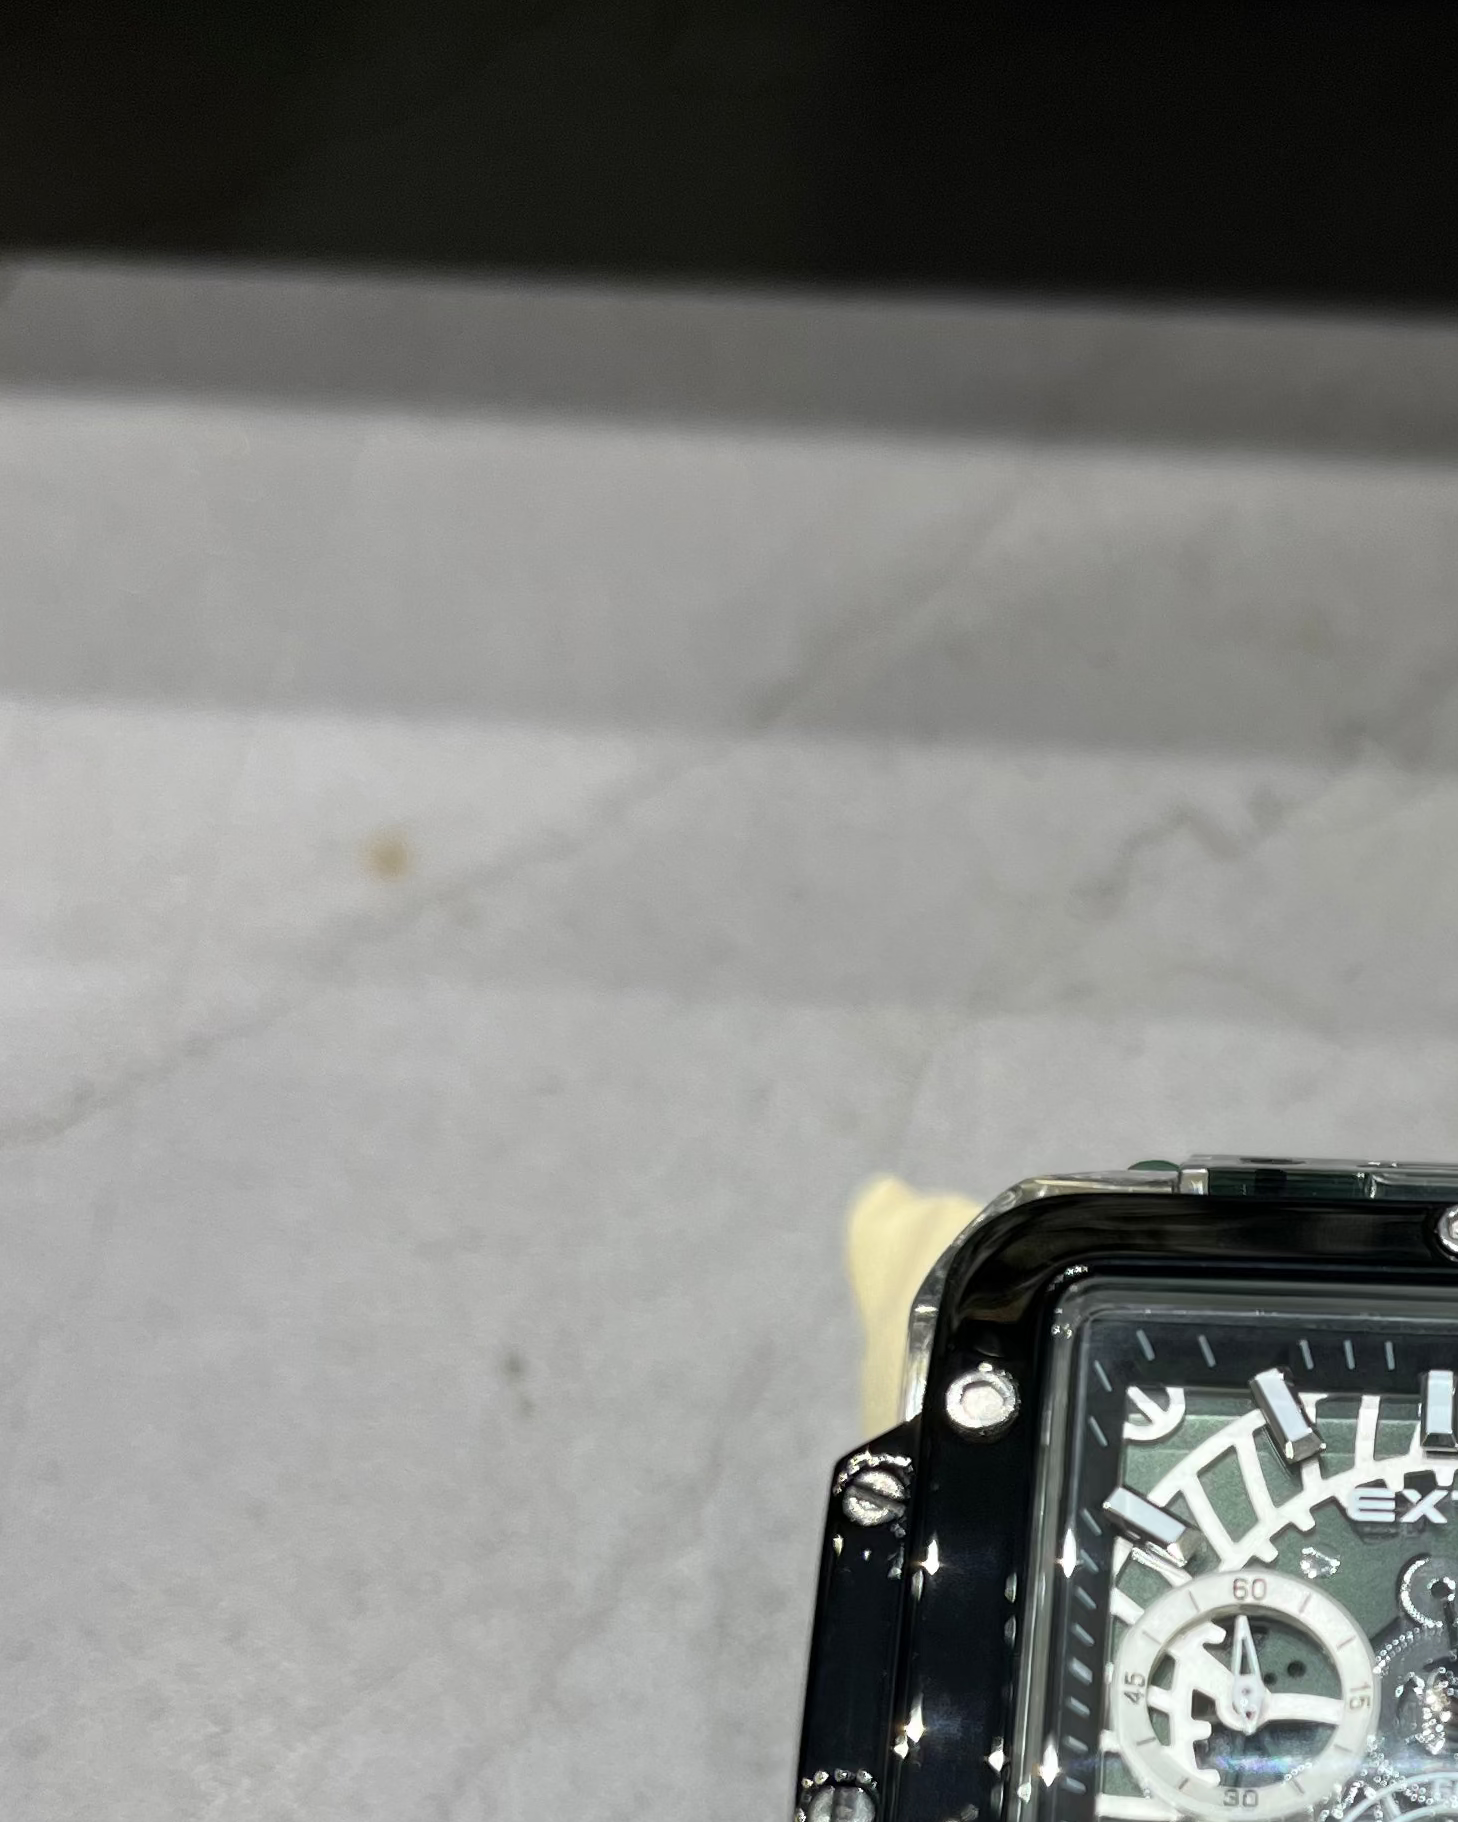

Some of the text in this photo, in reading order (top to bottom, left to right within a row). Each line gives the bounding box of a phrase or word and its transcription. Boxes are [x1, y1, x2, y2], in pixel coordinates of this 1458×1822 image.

[1232, 1578, 1267, 1600] 60
[1124, 1671, 1146, 1705] 45
[1349, 1682, 1371, 1710] 15
[1222, 1789, 1259, 1808] 30
